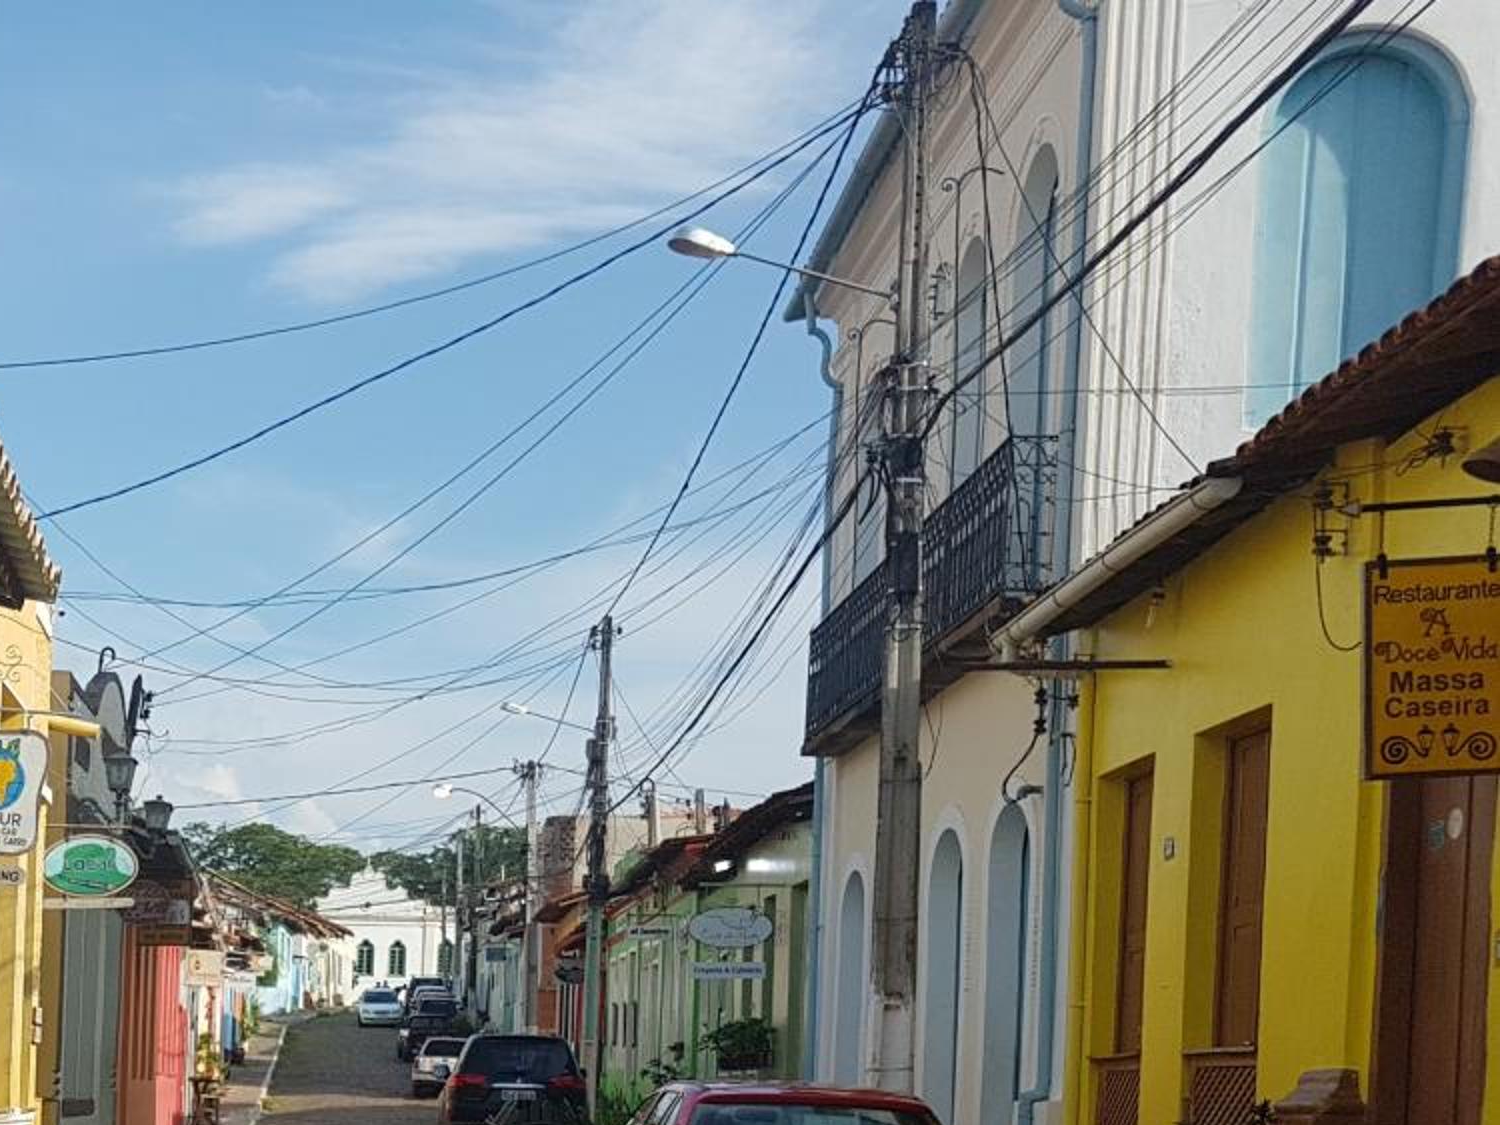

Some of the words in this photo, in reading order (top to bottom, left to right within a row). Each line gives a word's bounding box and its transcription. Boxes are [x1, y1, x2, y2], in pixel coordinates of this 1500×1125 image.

[1373, 580, 1500, 605] Restaurante
[1374, 640, 1440, 664] Doce
[1440, 634, 1498, 661] Vida
[1389, 670, 1484, 693] Massa
[1384, 696, 1490, 719] Caseira
